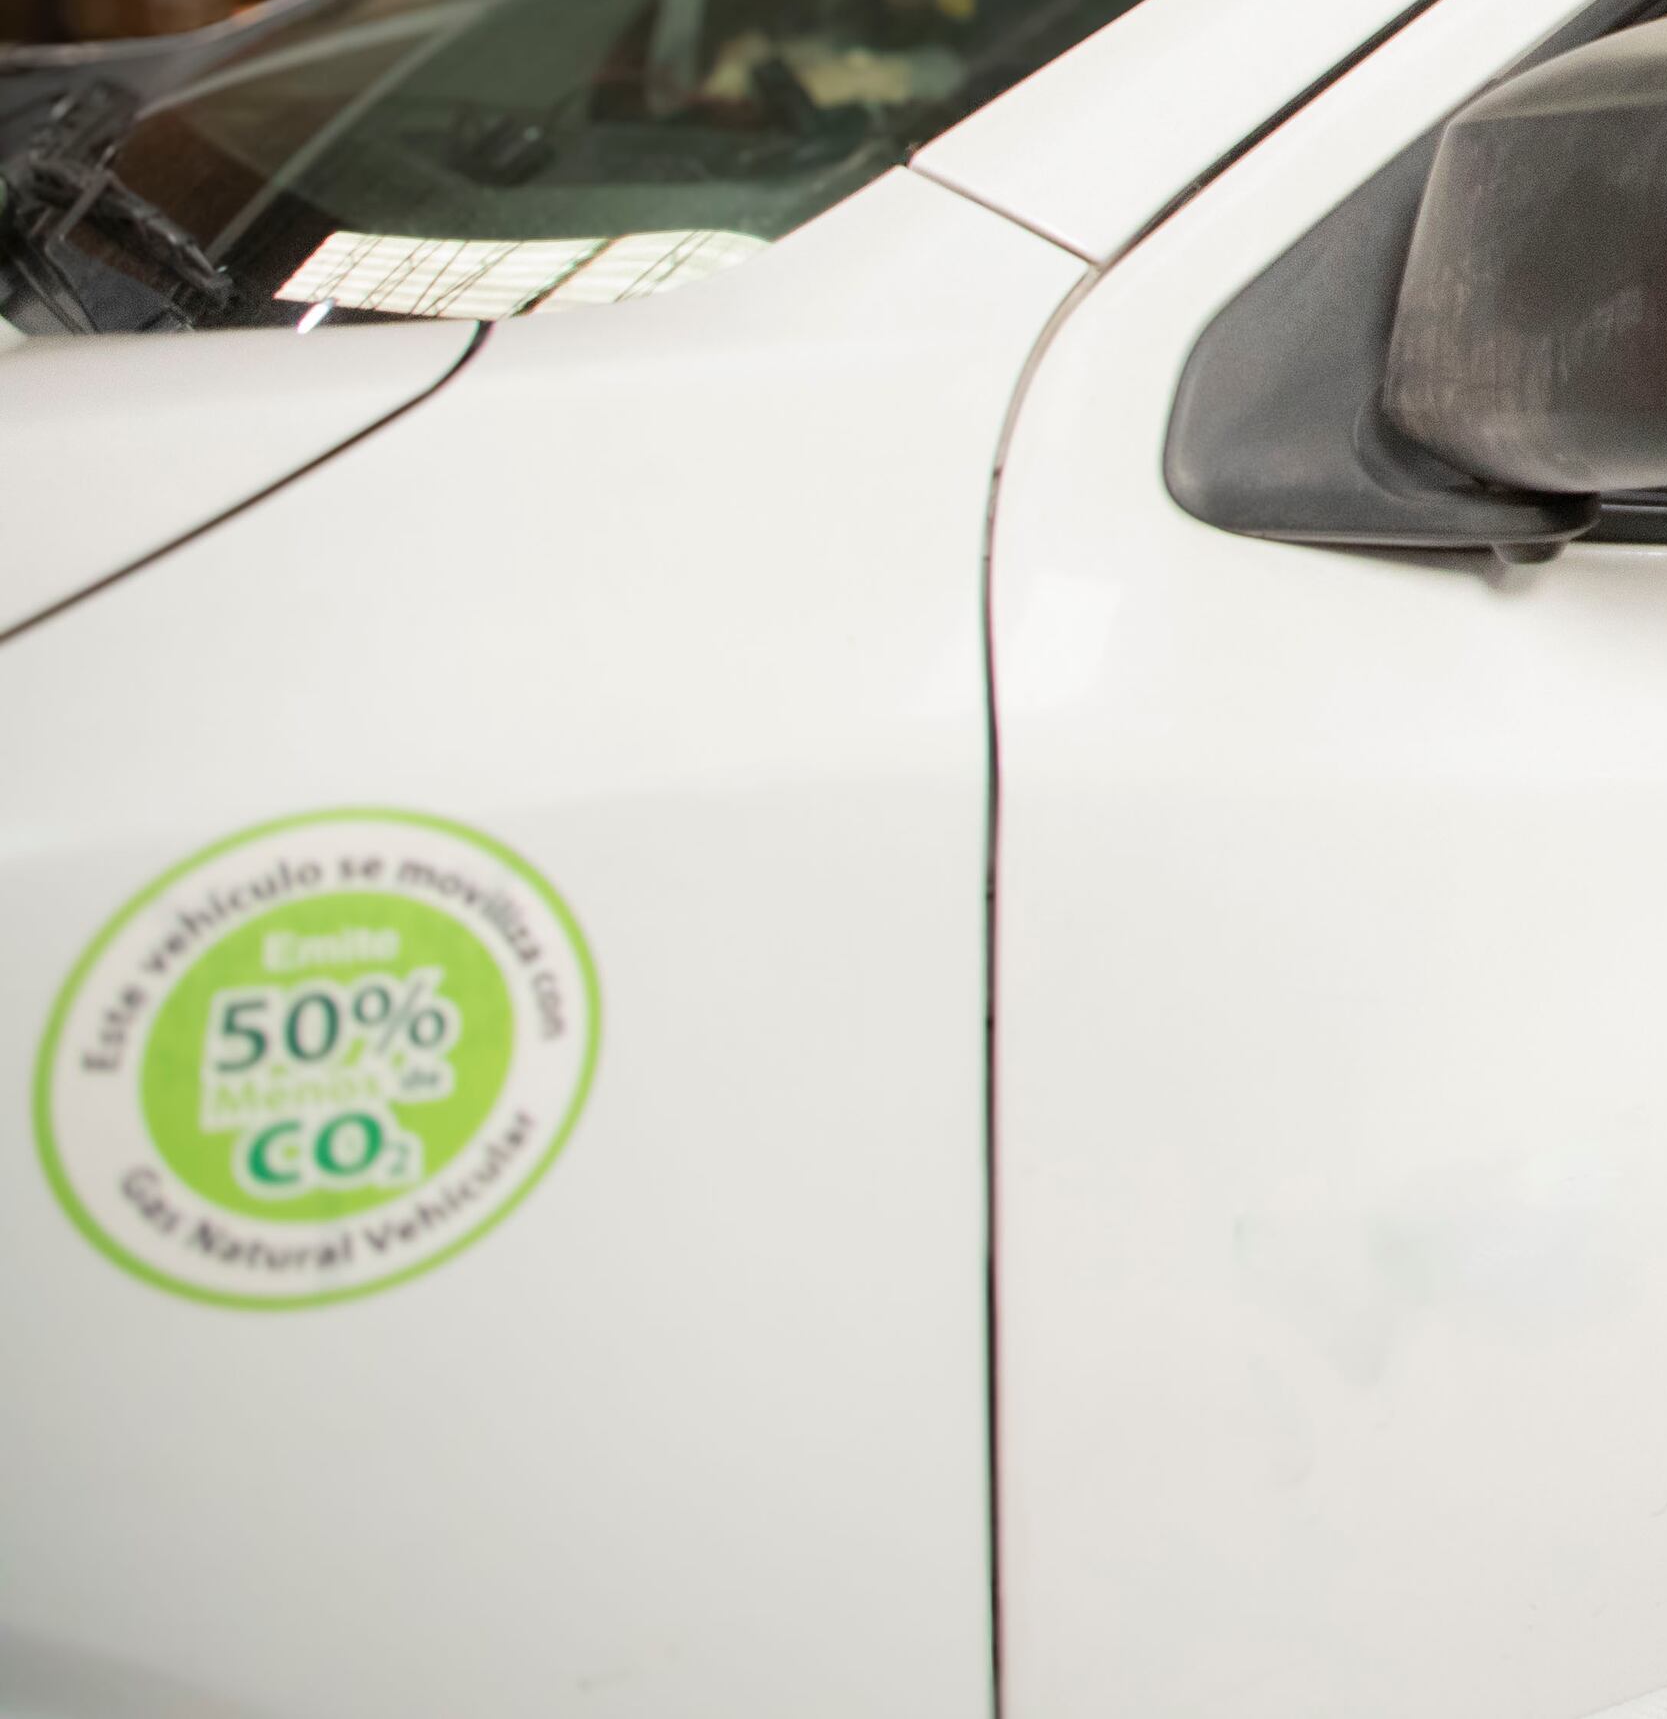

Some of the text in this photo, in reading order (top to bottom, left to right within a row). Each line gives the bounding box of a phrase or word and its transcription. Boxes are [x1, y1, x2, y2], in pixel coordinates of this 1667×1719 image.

[82, 986, 145, 1072] Este
[339, 855, 383, 883] se
[214, 978, 447, 1073] 50%
[120, 1112, 534, 1271] Gas Natural Vehicular
